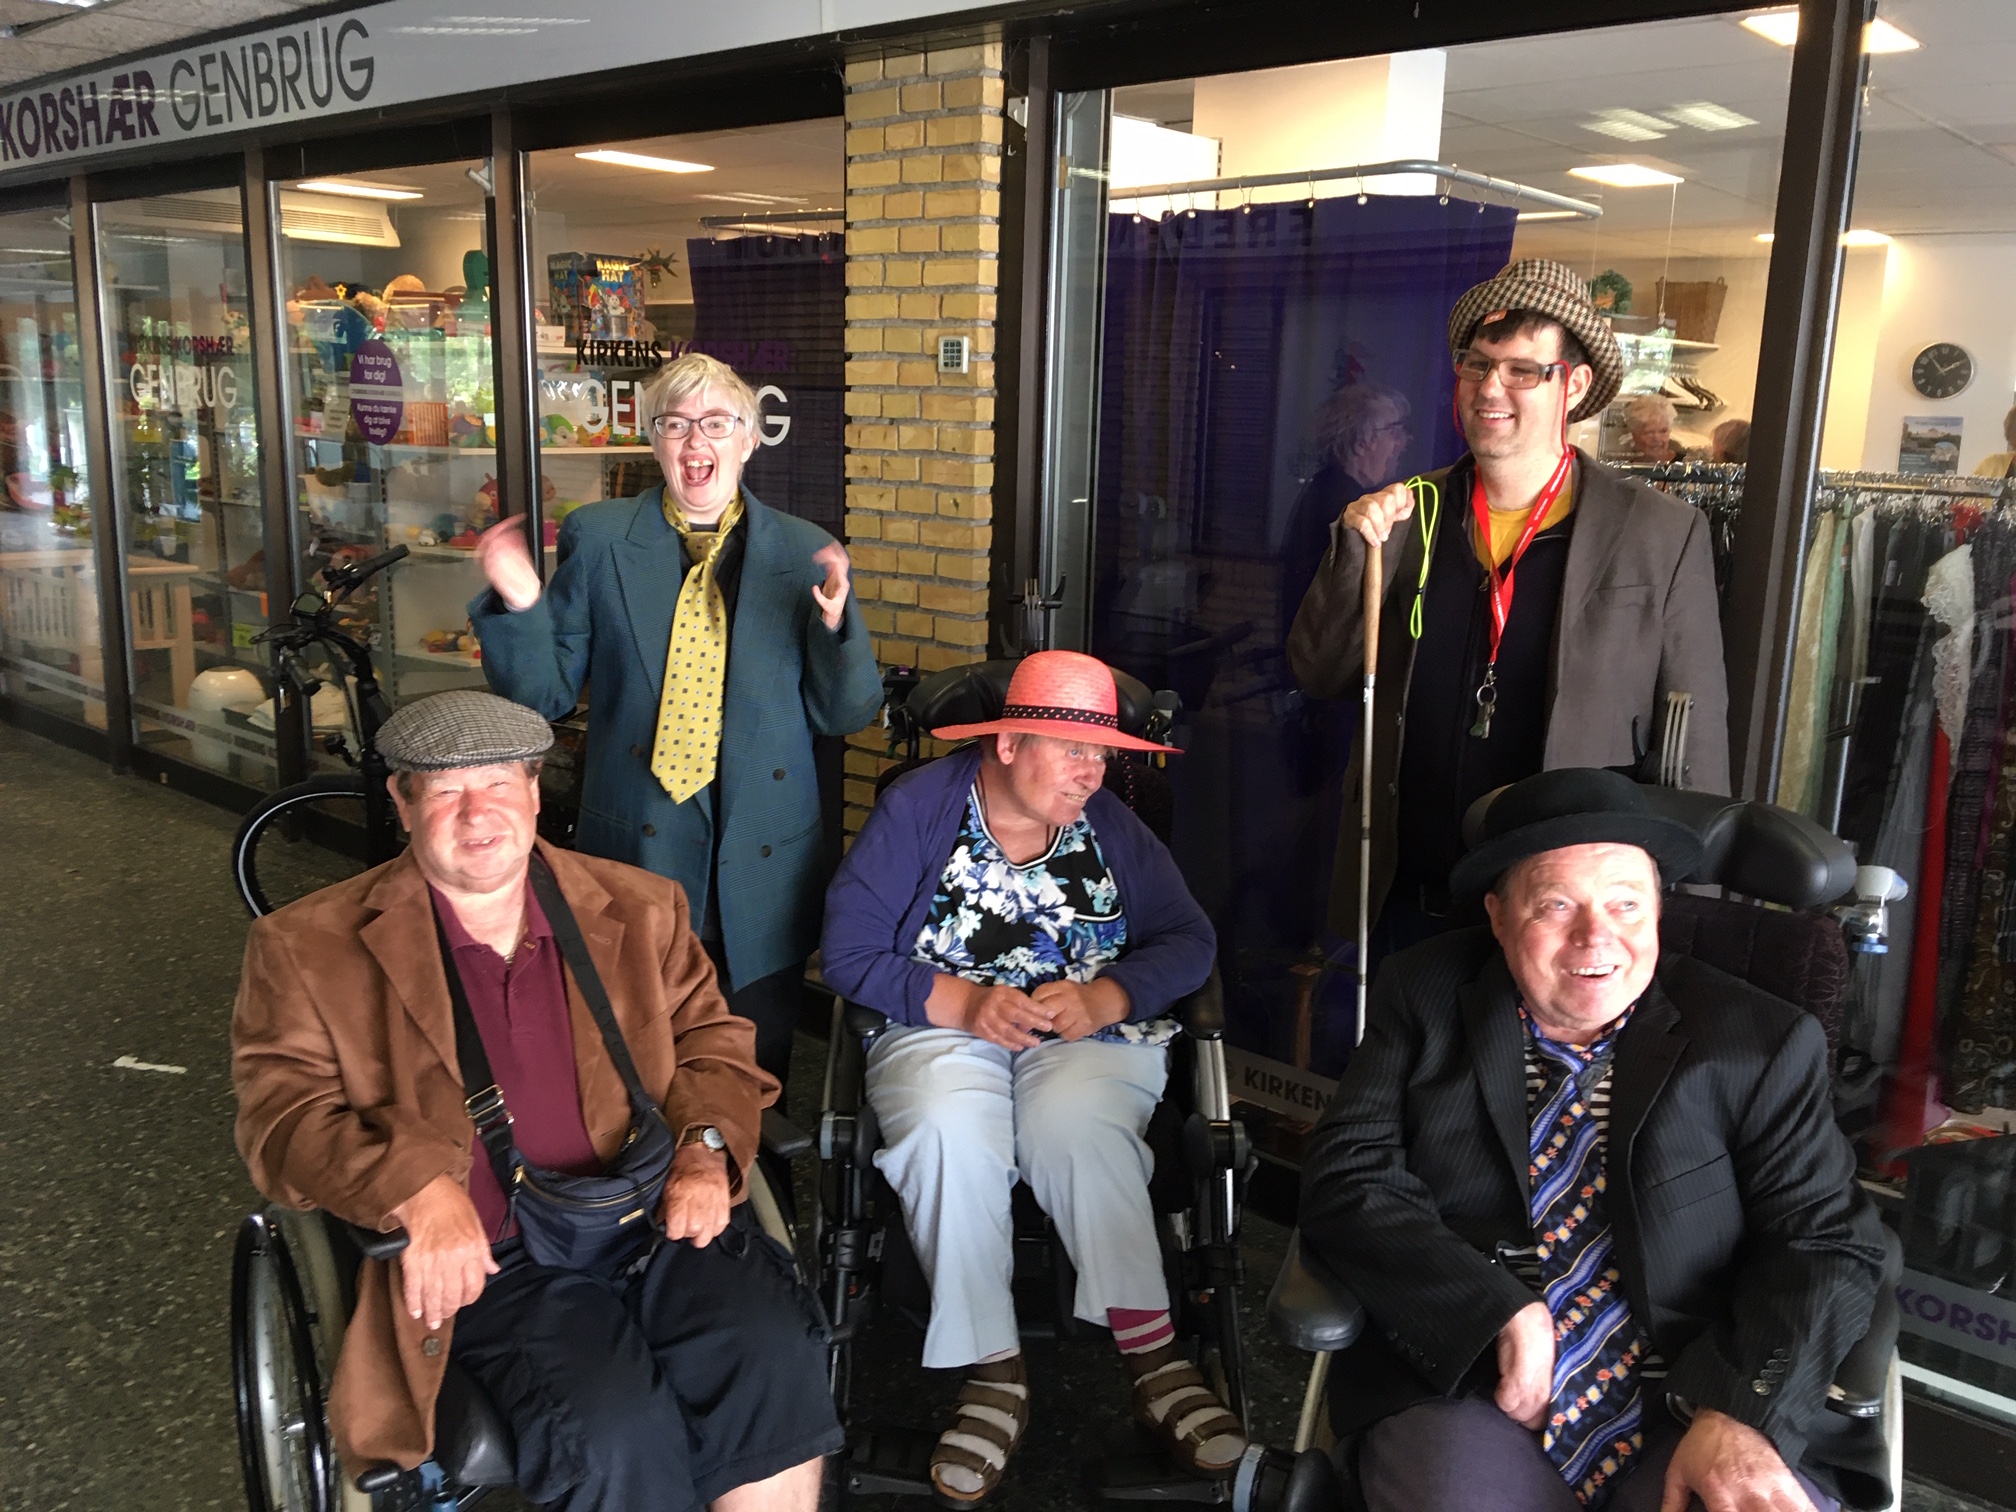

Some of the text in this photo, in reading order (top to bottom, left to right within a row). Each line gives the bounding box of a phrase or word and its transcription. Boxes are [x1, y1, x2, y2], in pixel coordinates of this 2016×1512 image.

[0, 18, 374, 162] KORSHÆR GENBRUG
[602, 270, 624, 282] HAT
[376, 355, 392, 369] brug
[576, 338, 663, 369] KIRKENS
[129, 363, 238, 409] GENBRUG
